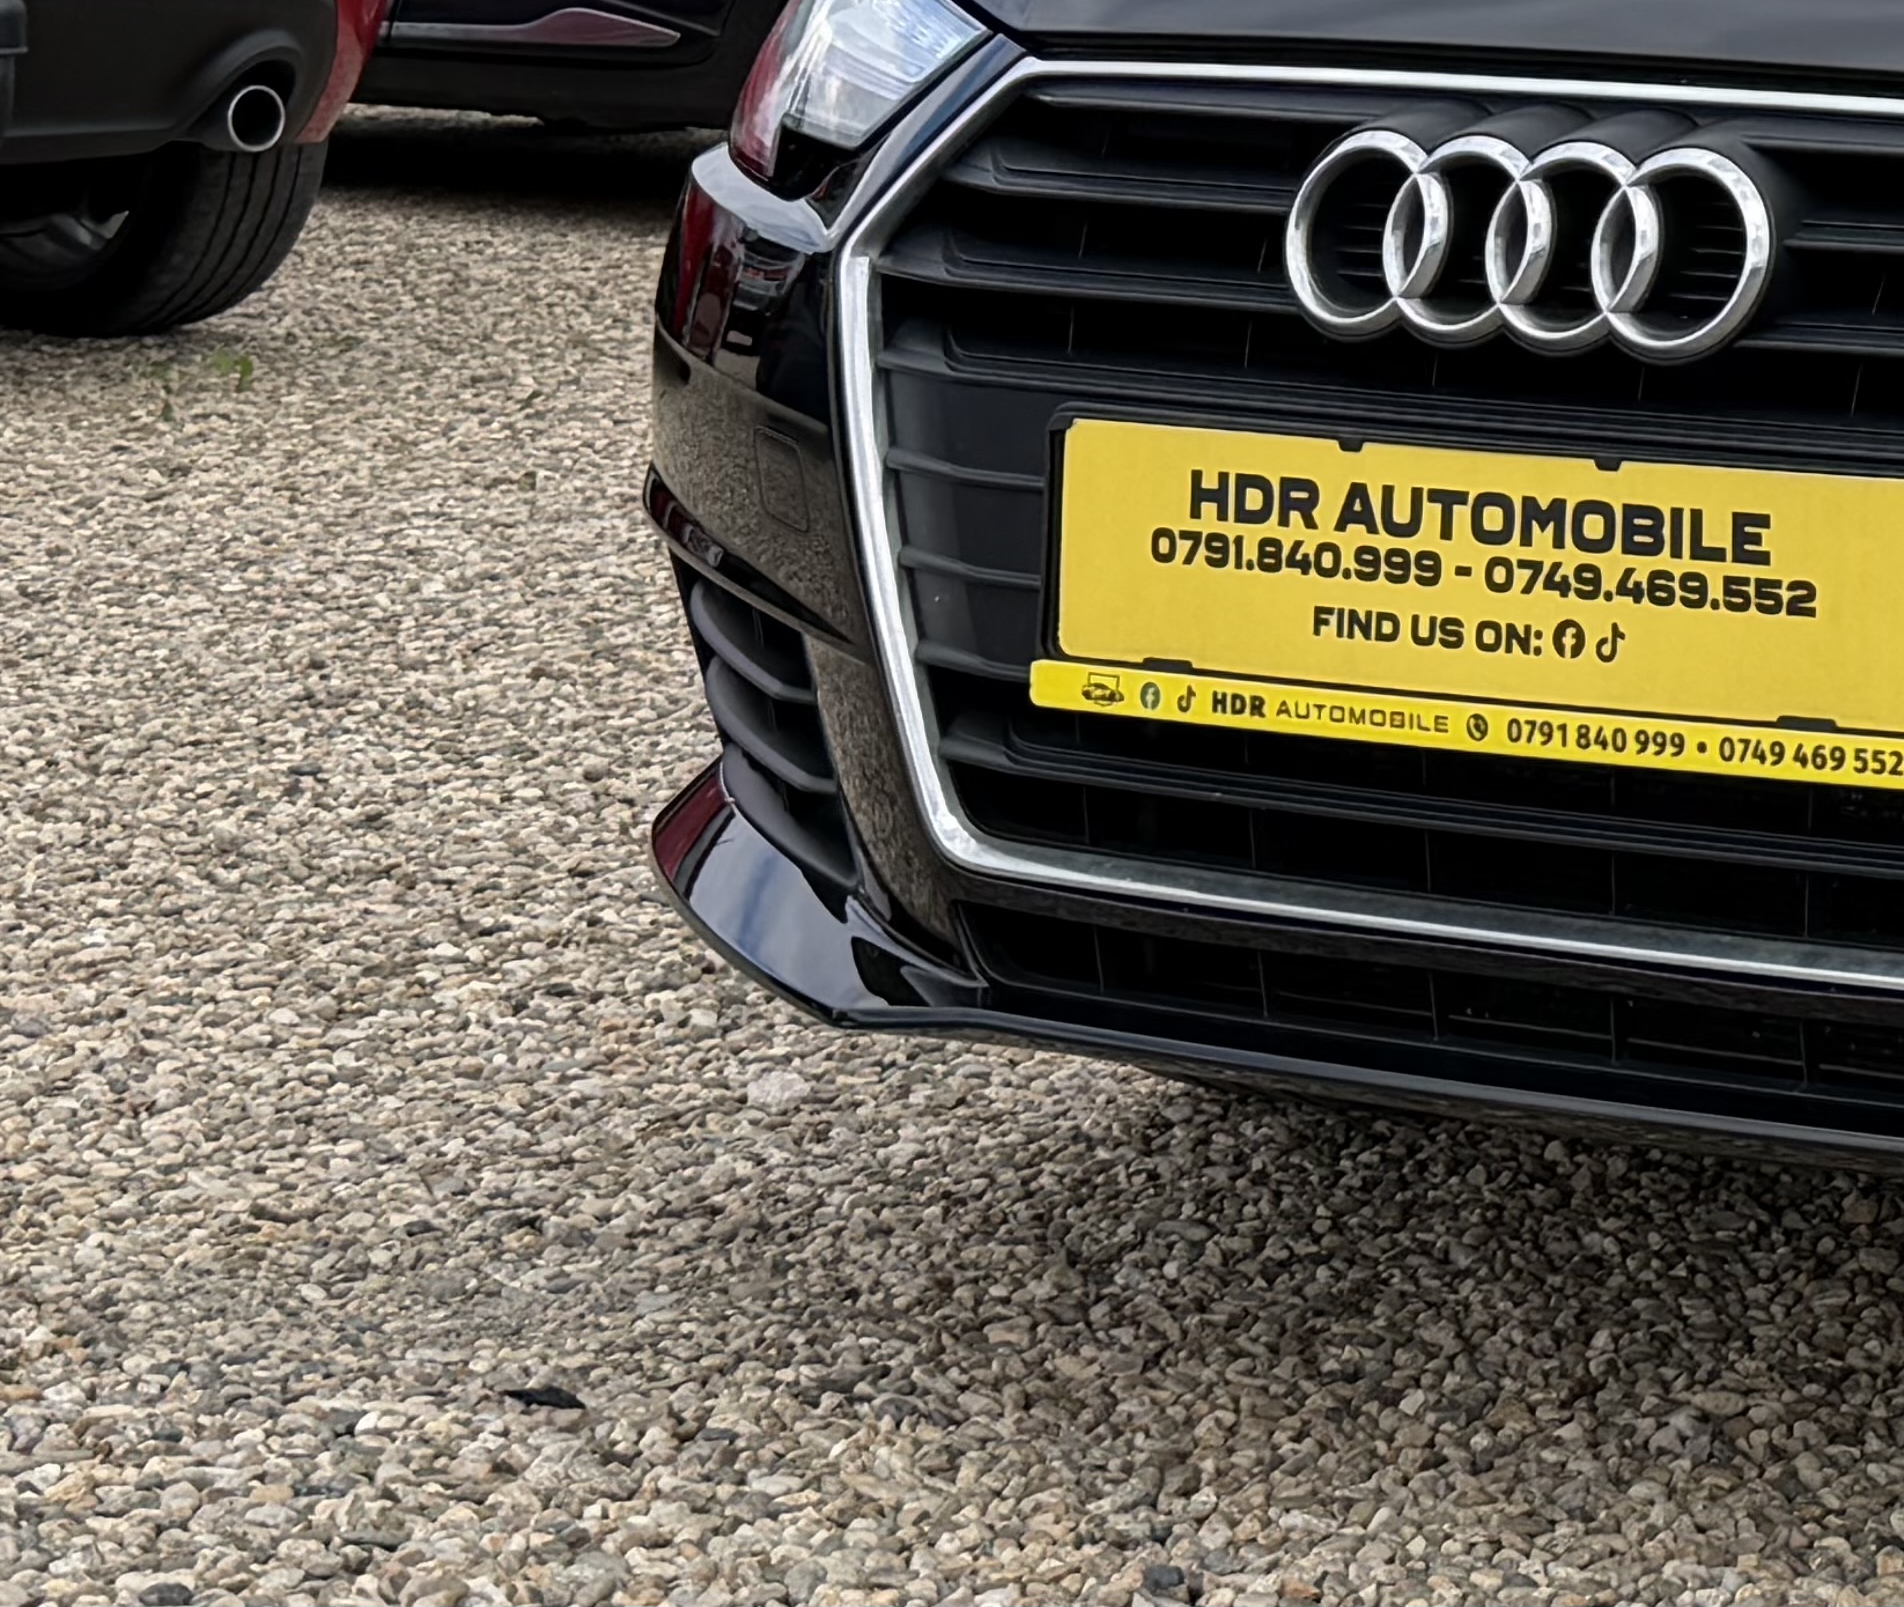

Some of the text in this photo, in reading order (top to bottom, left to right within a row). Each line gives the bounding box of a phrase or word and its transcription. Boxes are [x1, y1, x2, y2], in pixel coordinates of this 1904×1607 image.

[1190, 469, 1771, 567] HDR AUTOMOBILE
[1151, 527, 1442, 587] 0791.840.999
[1484, 556, 1817, 619] 0749.469.552
[1313, 605, 1543, 657] FIND US ON:
[1211, 690, 1904, 776] HDR AUTOMOBILE 0791 840 999 0749 469 552
